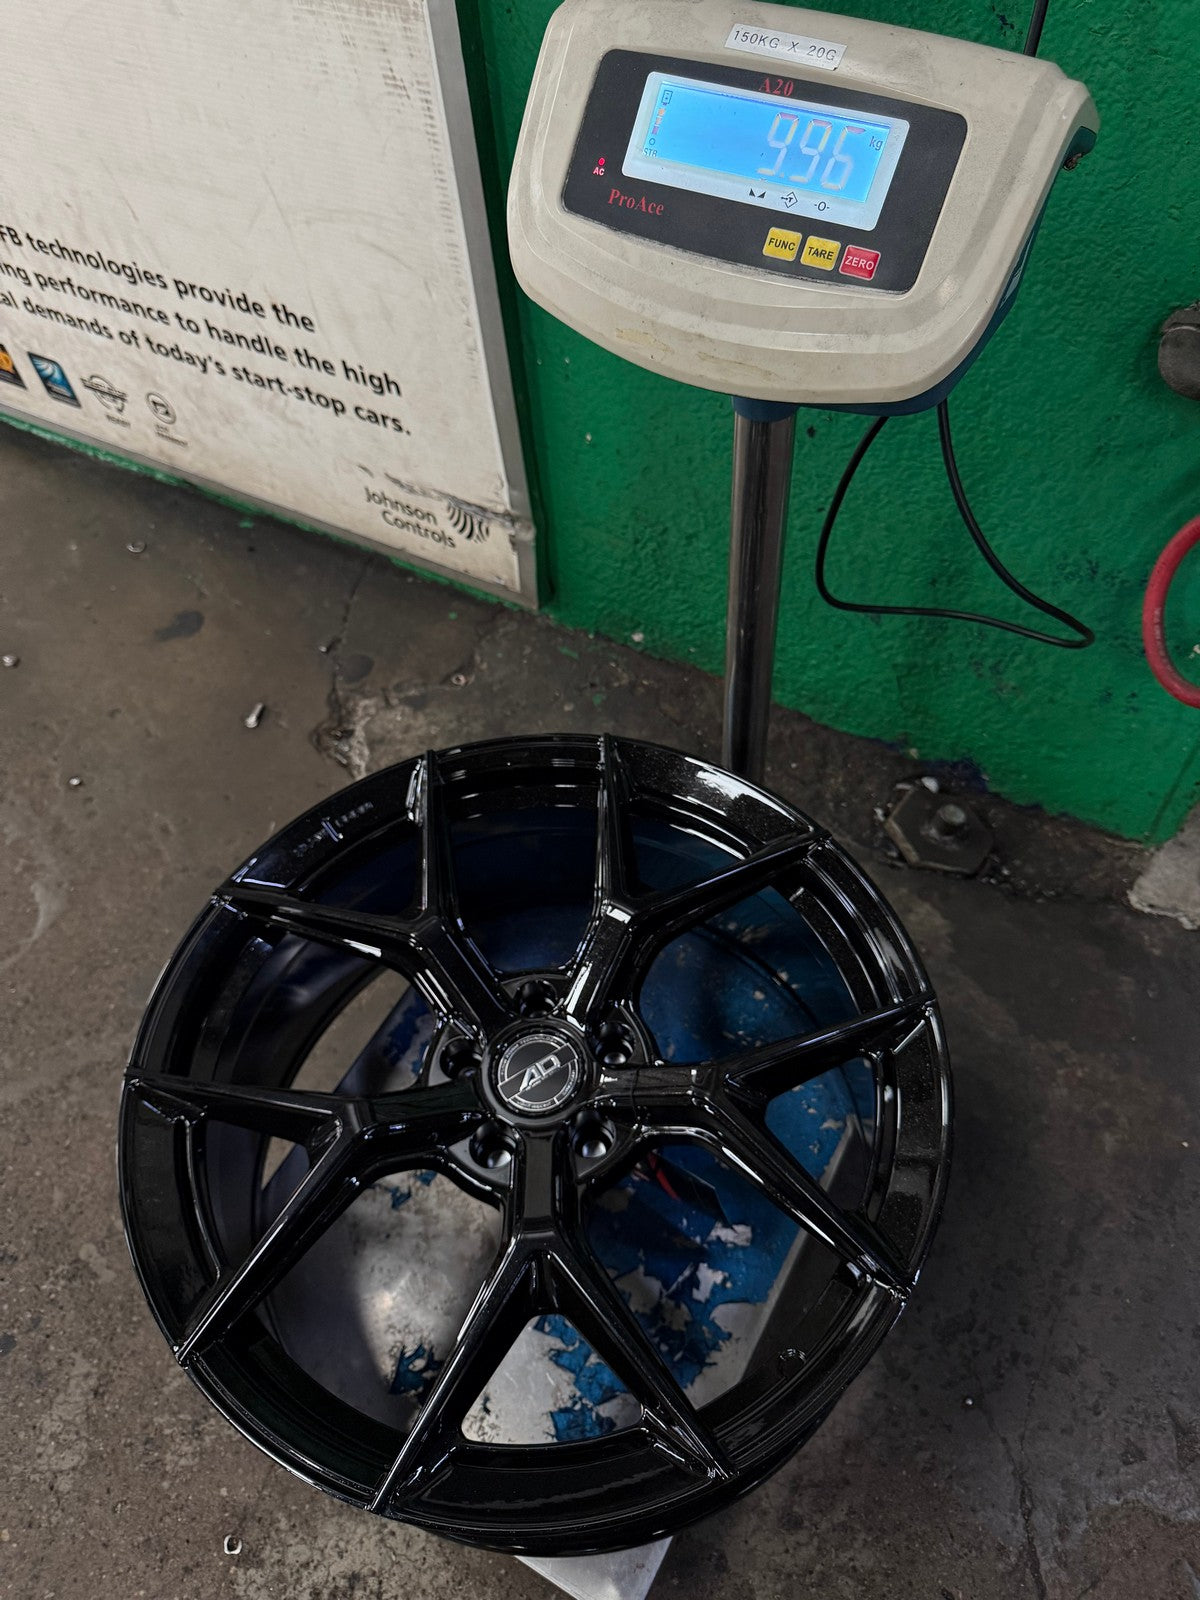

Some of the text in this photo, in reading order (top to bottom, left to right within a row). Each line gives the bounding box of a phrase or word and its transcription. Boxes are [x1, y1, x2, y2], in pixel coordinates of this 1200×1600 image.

[732, 29, 781, 50] 150KG
[806, 45, 838, 62] 20G
[758, 77, 795, 97] A20
[869, 135, 884, 150] kg
[592, 166, 605, 176] AC
[607, 187, 665, 216] ProAce
[767, 236, 797, 252] FUNC
[807, 246, 835, 262] TARE
[844, 254, 875, 271] ZERO
[26, 232, 168, 290] technologies
[173, 276, 266, 318] provide
[272, 303, 316, 333] the
[33, 271, 170, 326] performance
[175, 312, 201, 334] to
[205, 319, 289, 362] handle
[294, 347, 336, 377] the
[342, 359, 403, 398] high
[23, 296, 114, 340] demands
[118, 329, 142, 350] of
[145, 334, 227, 376] today's
[231, 364, 347, 417] start-stop
[354, 404, 412, 437] cars.
[363, 486, 438, 526] Johnson
[381, 510, 457, 549] Controls
